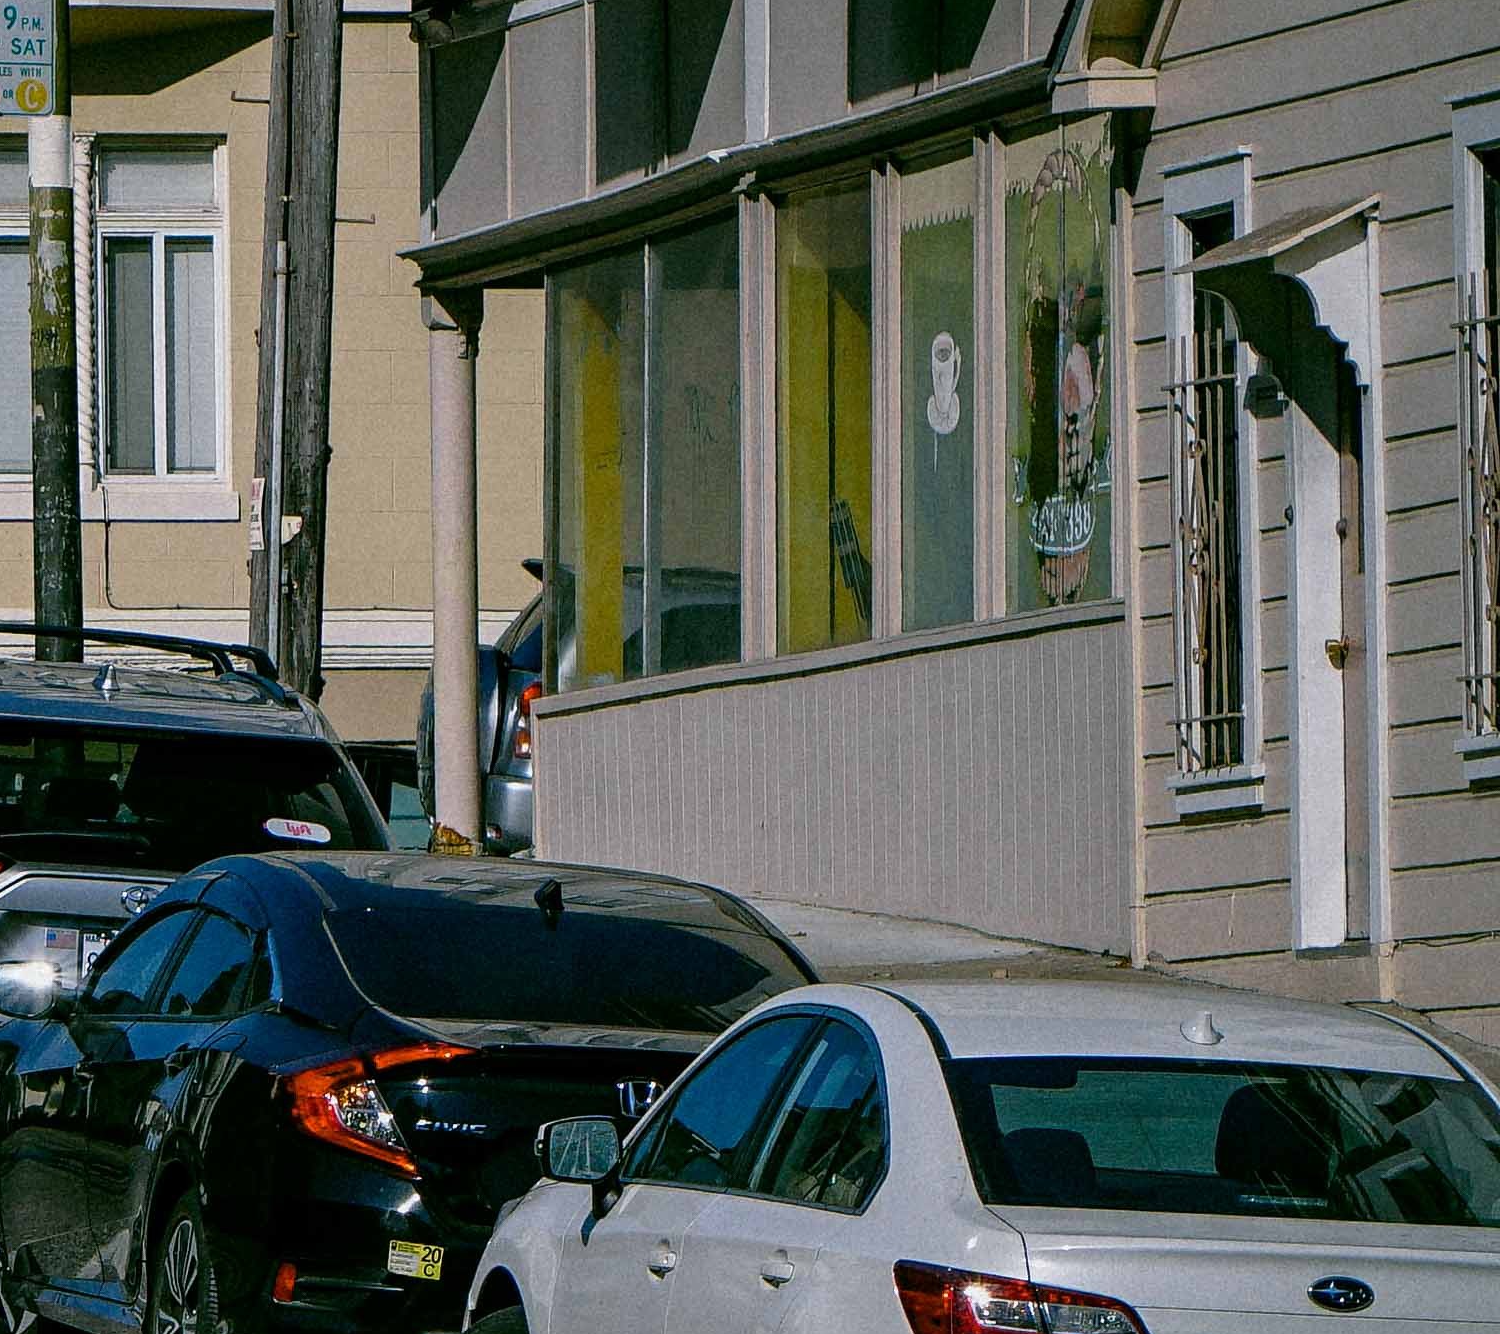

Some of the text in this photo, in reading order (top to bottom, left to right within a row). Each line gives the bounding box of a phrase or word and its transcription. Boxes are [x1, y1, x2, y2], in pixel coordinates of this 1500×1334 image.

[3, 5, 18, 30] 9
[21, 17, 45, 31] P.M.
[11, 37, 47, 55] SAT
[20, 67, 43, 77] WITH
[3, 89, 14, 100] OR
[24, 83, 39, 108] C
[421, 1246, 442, 1264] 20
[423, 1264, 436, 1278] C
